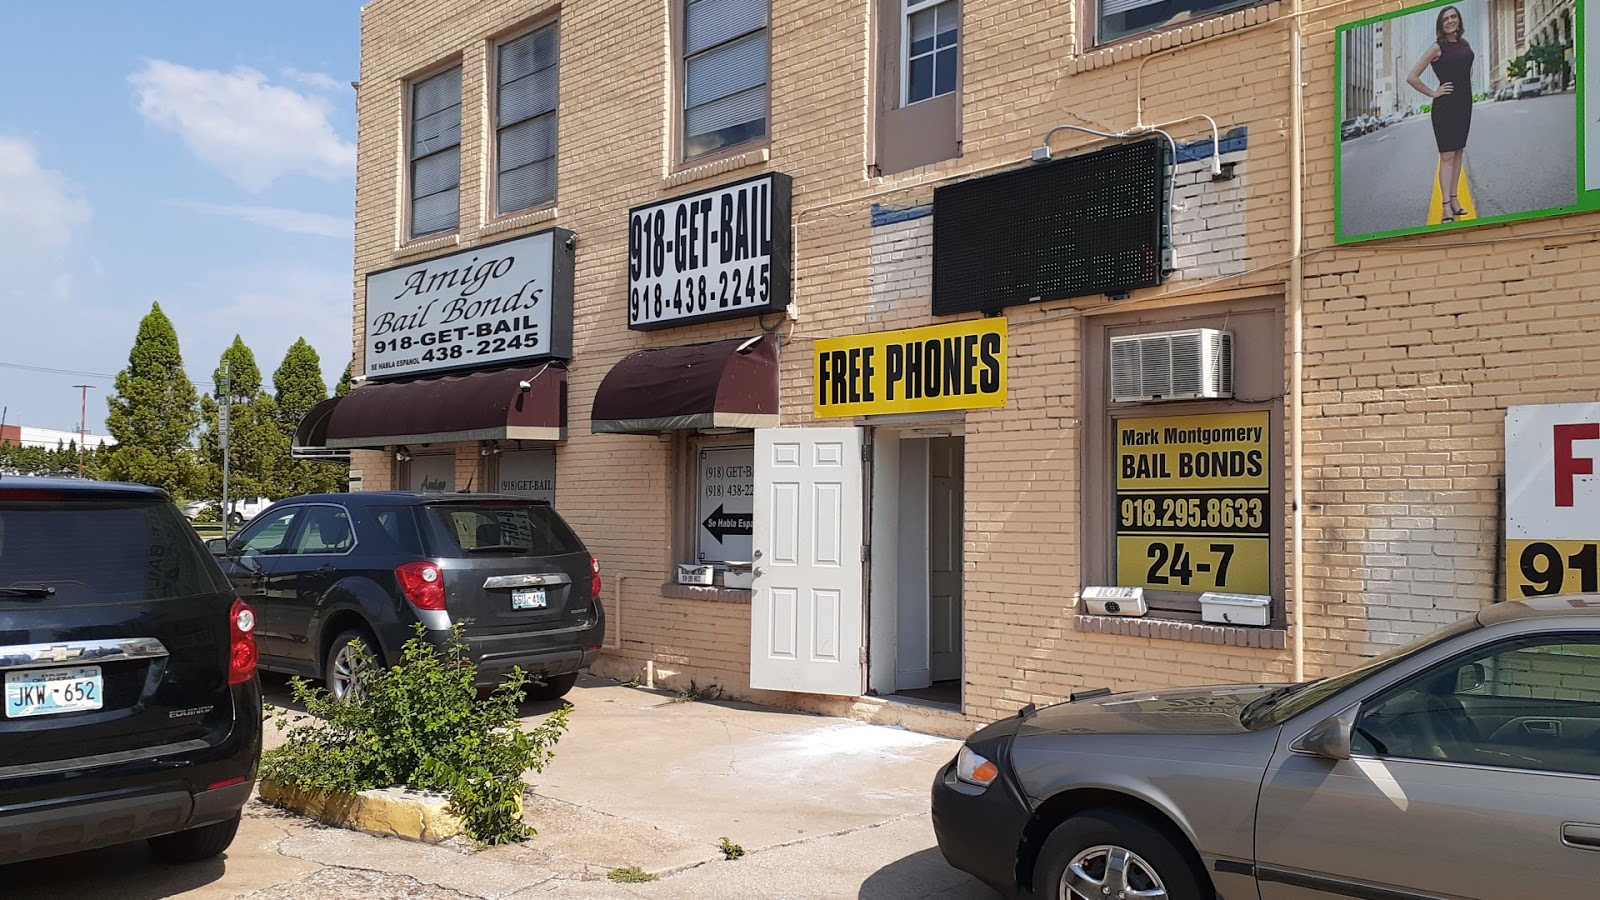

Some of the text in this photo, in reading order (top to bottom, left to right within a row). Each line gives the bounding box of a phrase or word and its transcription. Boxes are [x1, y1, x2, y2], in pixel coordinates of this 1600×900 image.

[631, 183, 770, 282] 918-GET-BAIL
[394, 256, 515, 300] Amigo
[632, 263, 769, 322] 918-438-2245
[371, 279, 543, 337] Bail Bonds
[374, 315, 538, 354] 918-GET-BAIL
[371, 363, 378, 371] SE
[378, 361, 395, 370] HABLA
[819, 332, 1001, 406] FREE PHONES
[1122, 426, 1263, 446] Mark Montgomery
[705, 465, 754, 480] (918) GET-B
[1122, 450, 1263, 479] BAIL BONDS
[1553, 423, 1600, 507] F
[705, 484, 725, 498] (918)
[707, 518, 717, 528] Se
[718, 518, 737, 528] Habla
[1121, 498, 1263, 528] 918.295.8633
[1146, 542, 1235, 588] 24-7
[32, 675, 76, 683] OKLAHOMA
